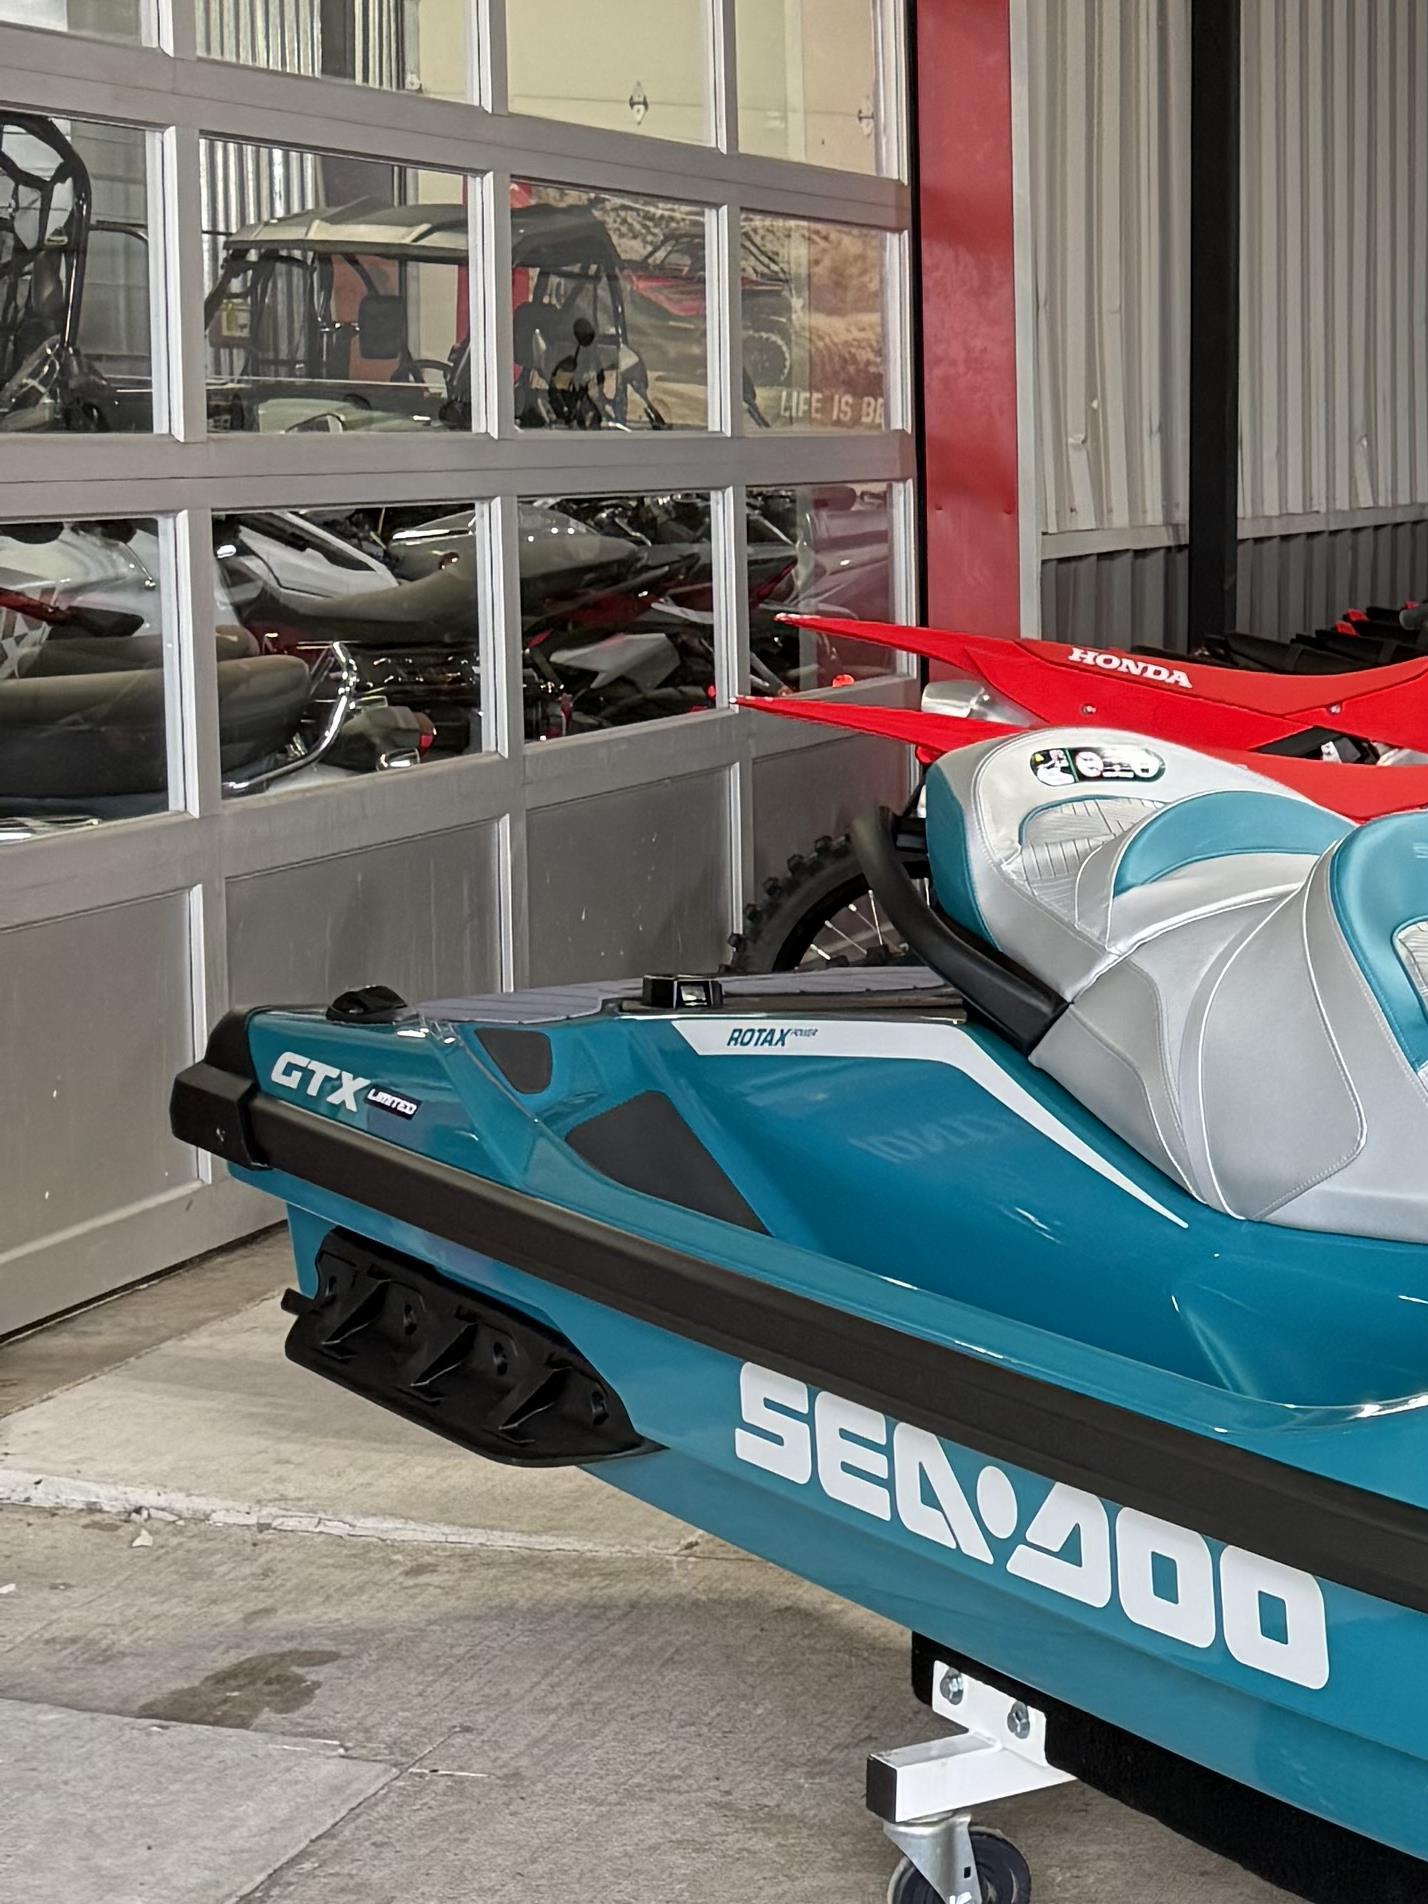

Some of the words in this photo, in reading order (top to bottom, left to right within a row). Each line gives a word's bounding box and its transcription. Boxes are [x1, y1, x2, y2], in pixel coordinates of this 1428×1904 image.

[781, 389, 822, 418] LIFE
[832, 393, 853, 421] IS
[1068, 647, 1193, 688] HONDA
[726, 1028, 792, 1047] ROTAX
[271, 1051, 371, 1112] GTX
[367, 1088, 418, 1115] LIMITED
